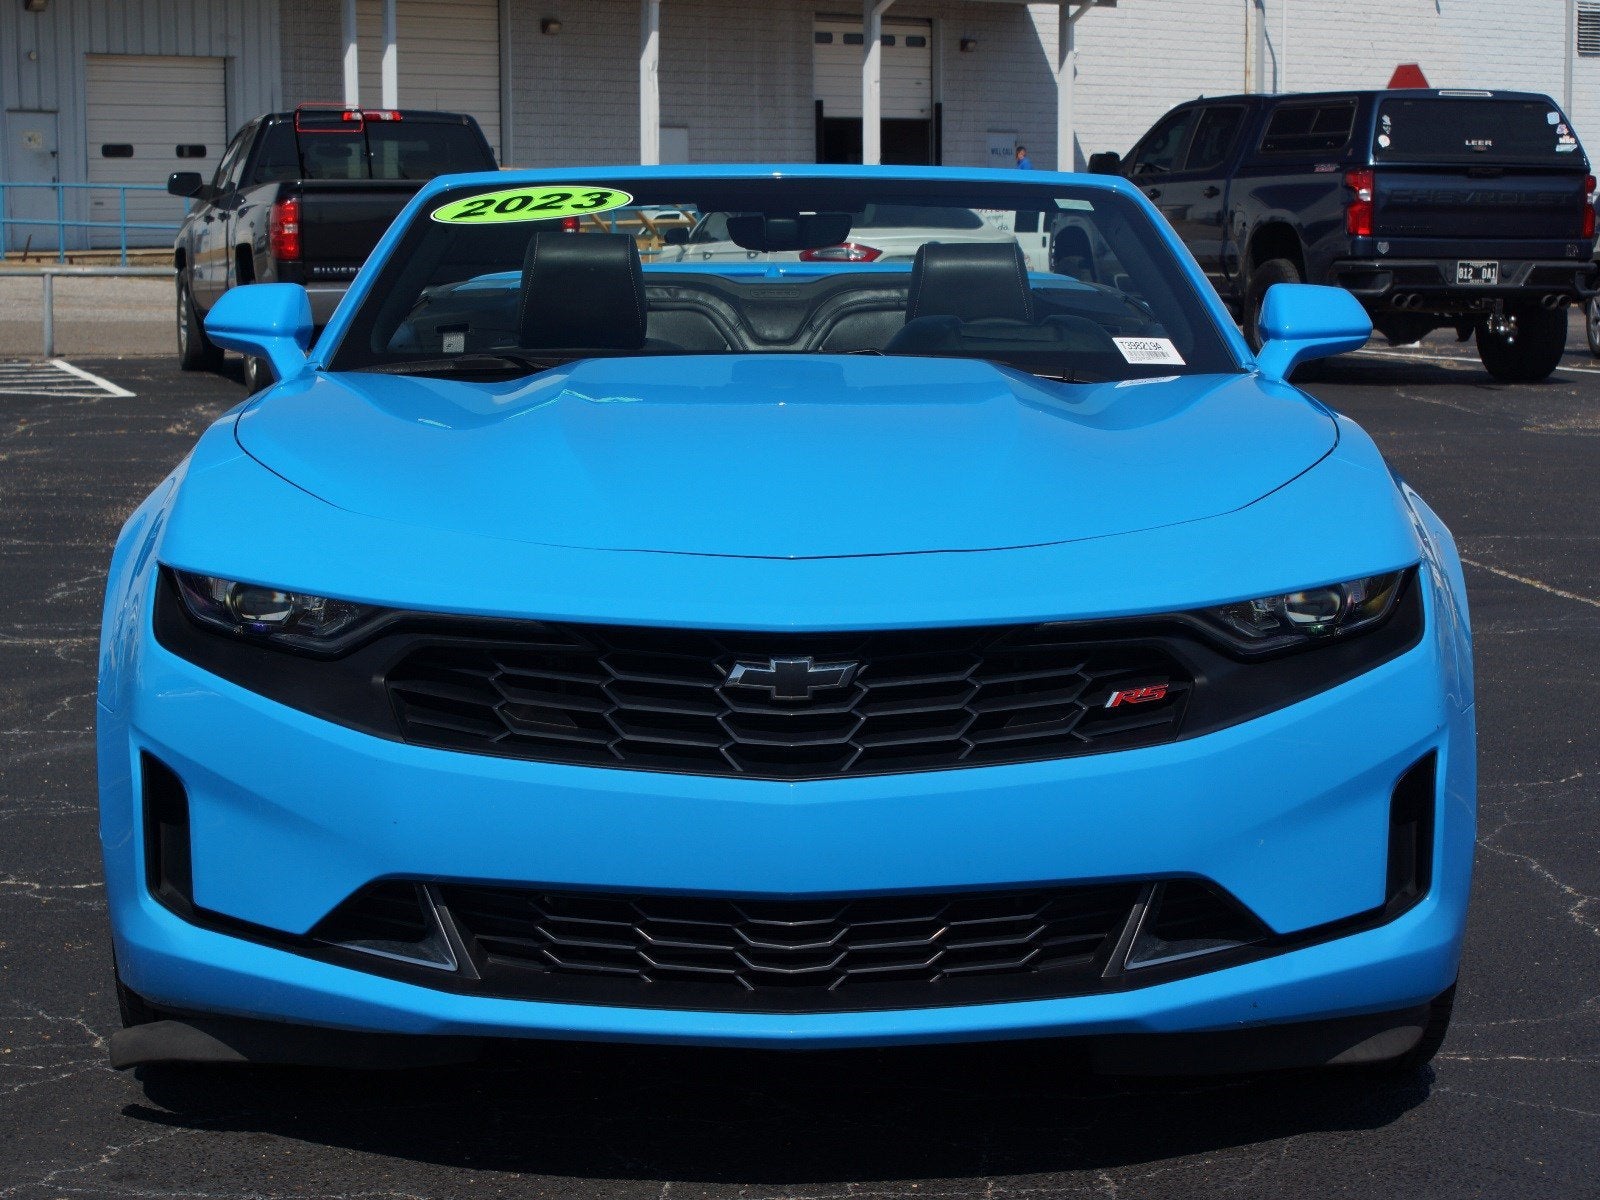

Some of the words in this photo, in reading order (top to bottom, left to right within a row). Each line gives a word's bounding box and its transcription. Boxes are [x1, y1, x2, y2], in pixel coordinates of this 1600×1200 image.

[1465, 139, 1493, 147] LEER
[451, 191, 613, 220] 2023
[1458, 268, 1473, 279] 812
[1110, 684, 1168, 708] RS
